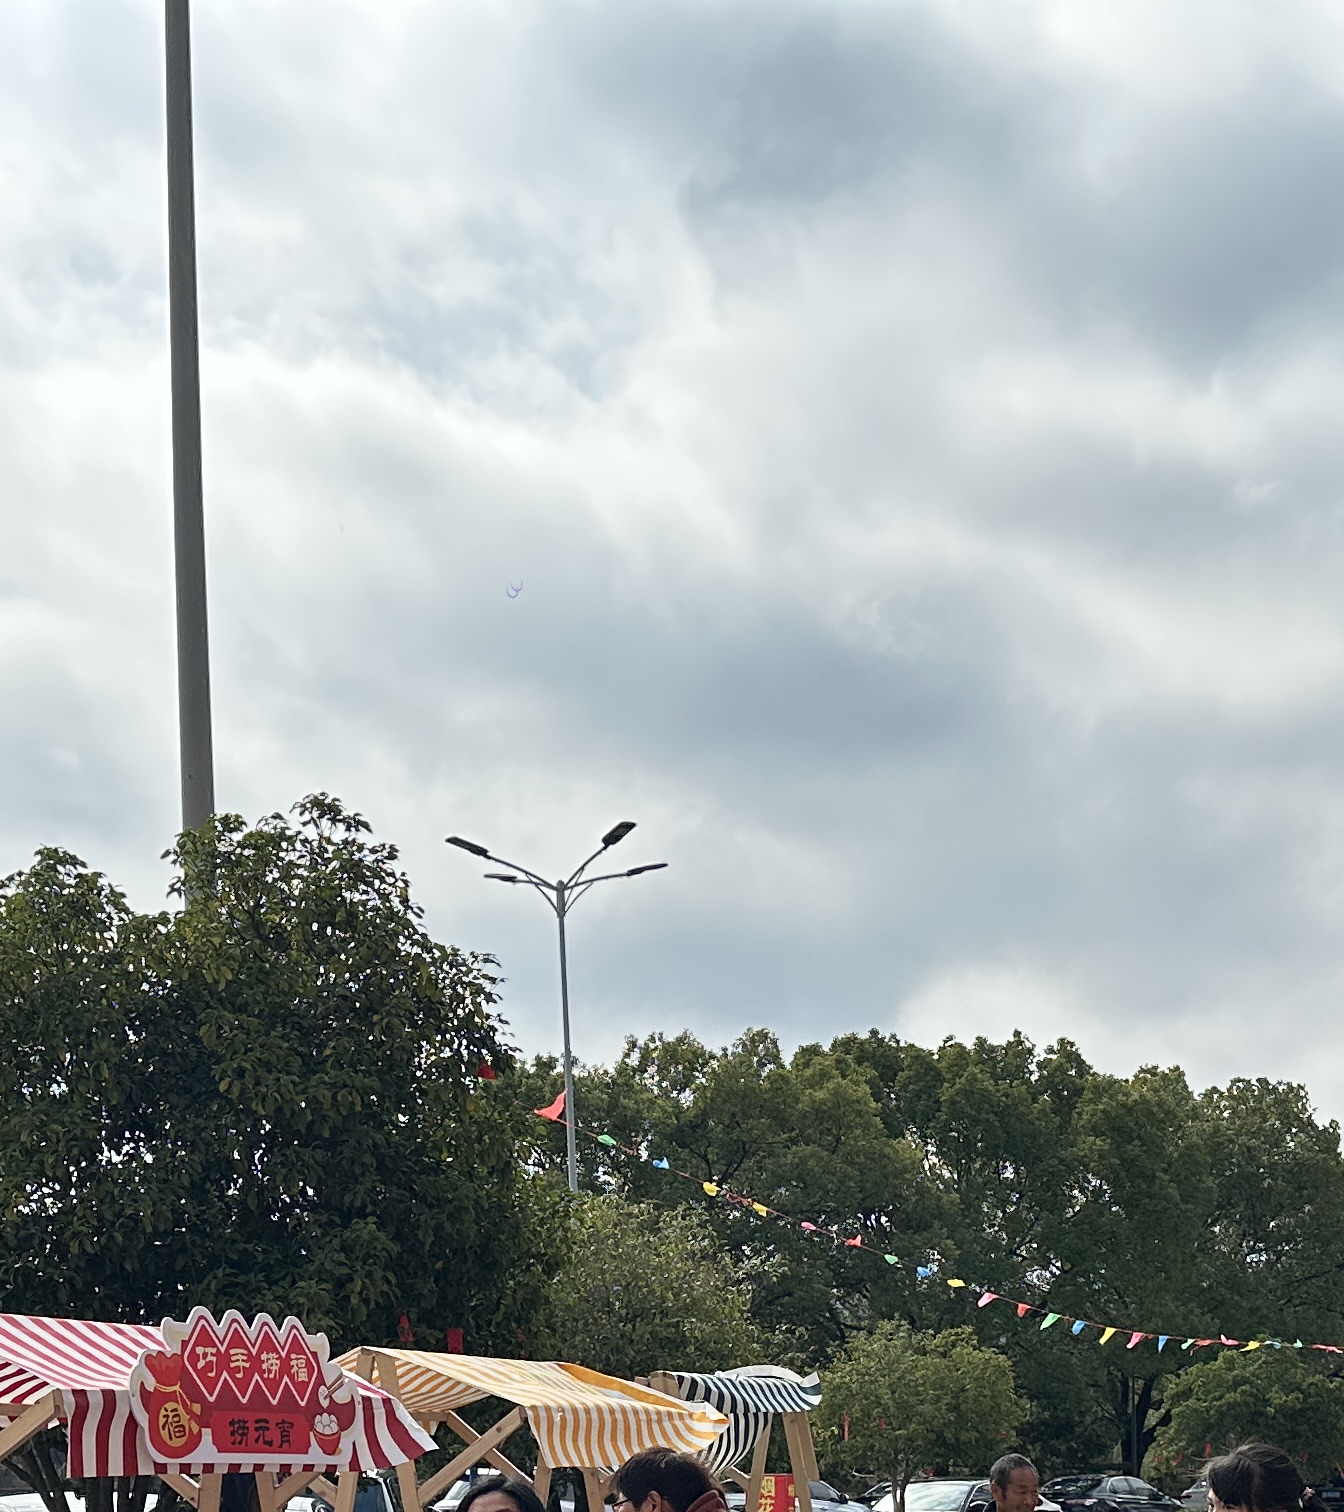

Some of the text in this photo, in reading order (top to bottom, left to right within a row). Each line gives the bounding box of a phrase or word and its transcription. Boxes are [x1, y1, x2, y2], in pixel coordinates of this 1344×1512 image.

[194, 1345, 310, 1382] 巧手捞福
[161, 1406, 188, 1441] 福
[228, 1417, 295, 1449] 捞元宵
